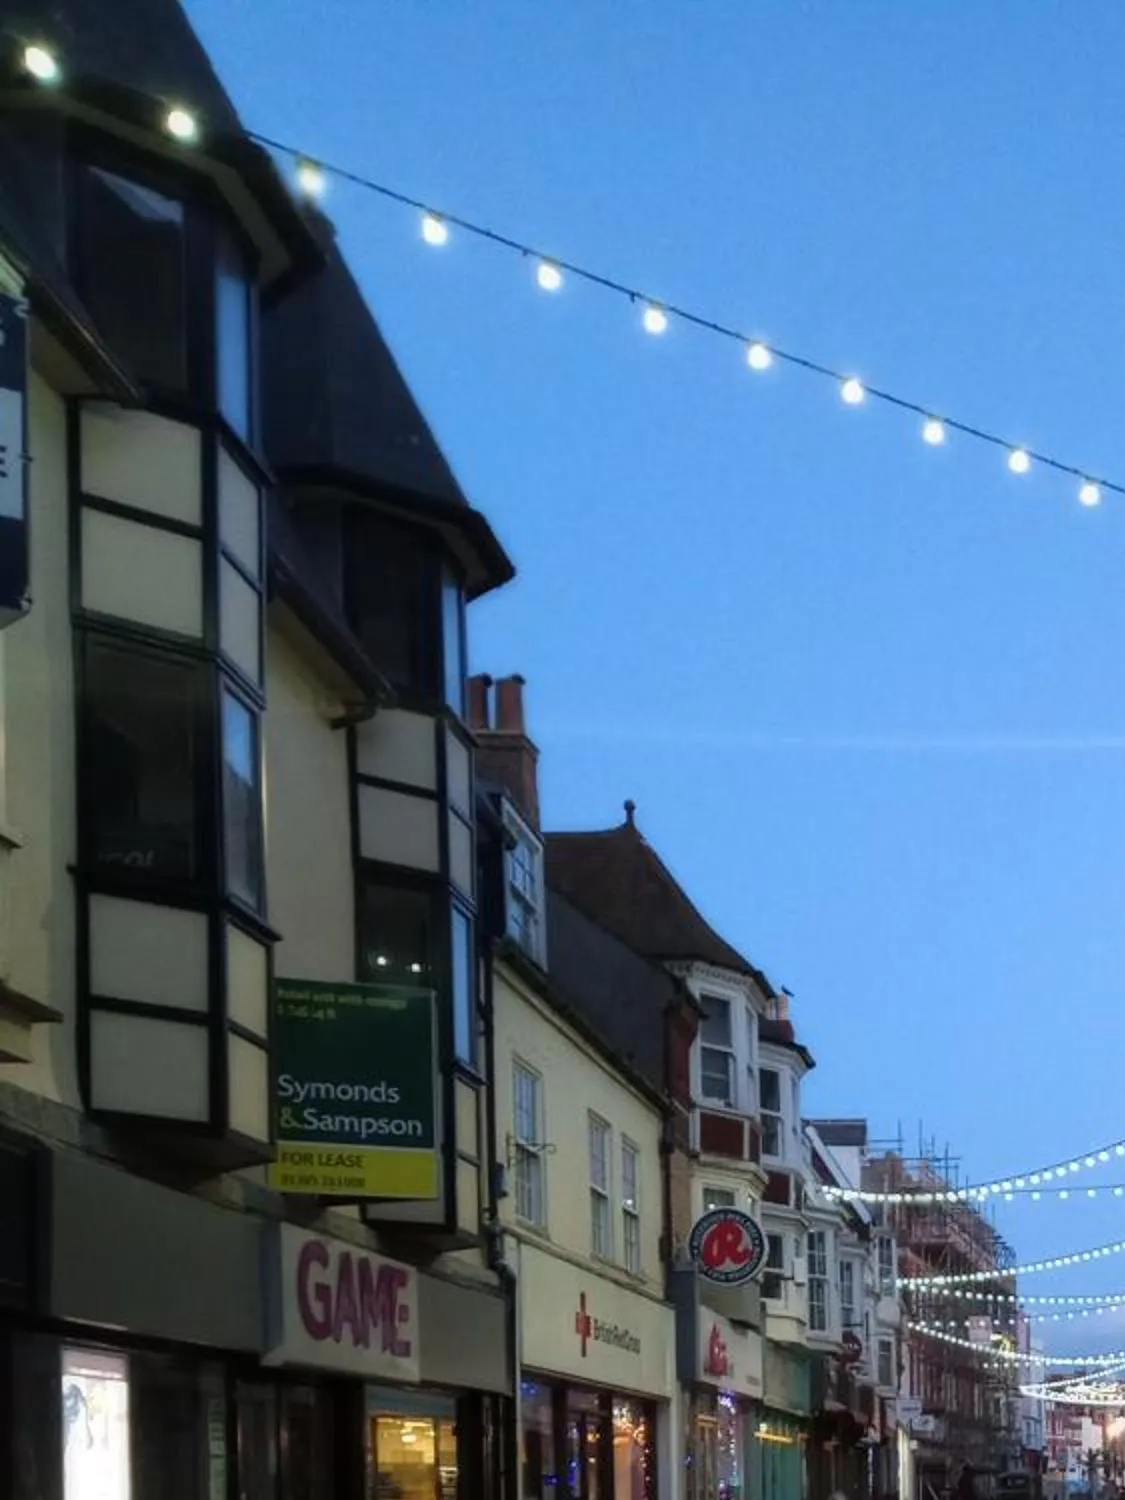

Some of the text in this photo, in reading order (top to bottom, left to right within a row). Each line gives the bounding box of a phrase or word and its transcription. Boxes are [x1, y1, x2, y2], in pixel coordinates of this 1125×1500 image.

[277, 1073, 401, 1104] Symonds
[303, 1107, 423, 1139] Sampson
[281, 1151, 366, 1169] FOR LEASE
[296, 1239, 412, 1359] GAME
